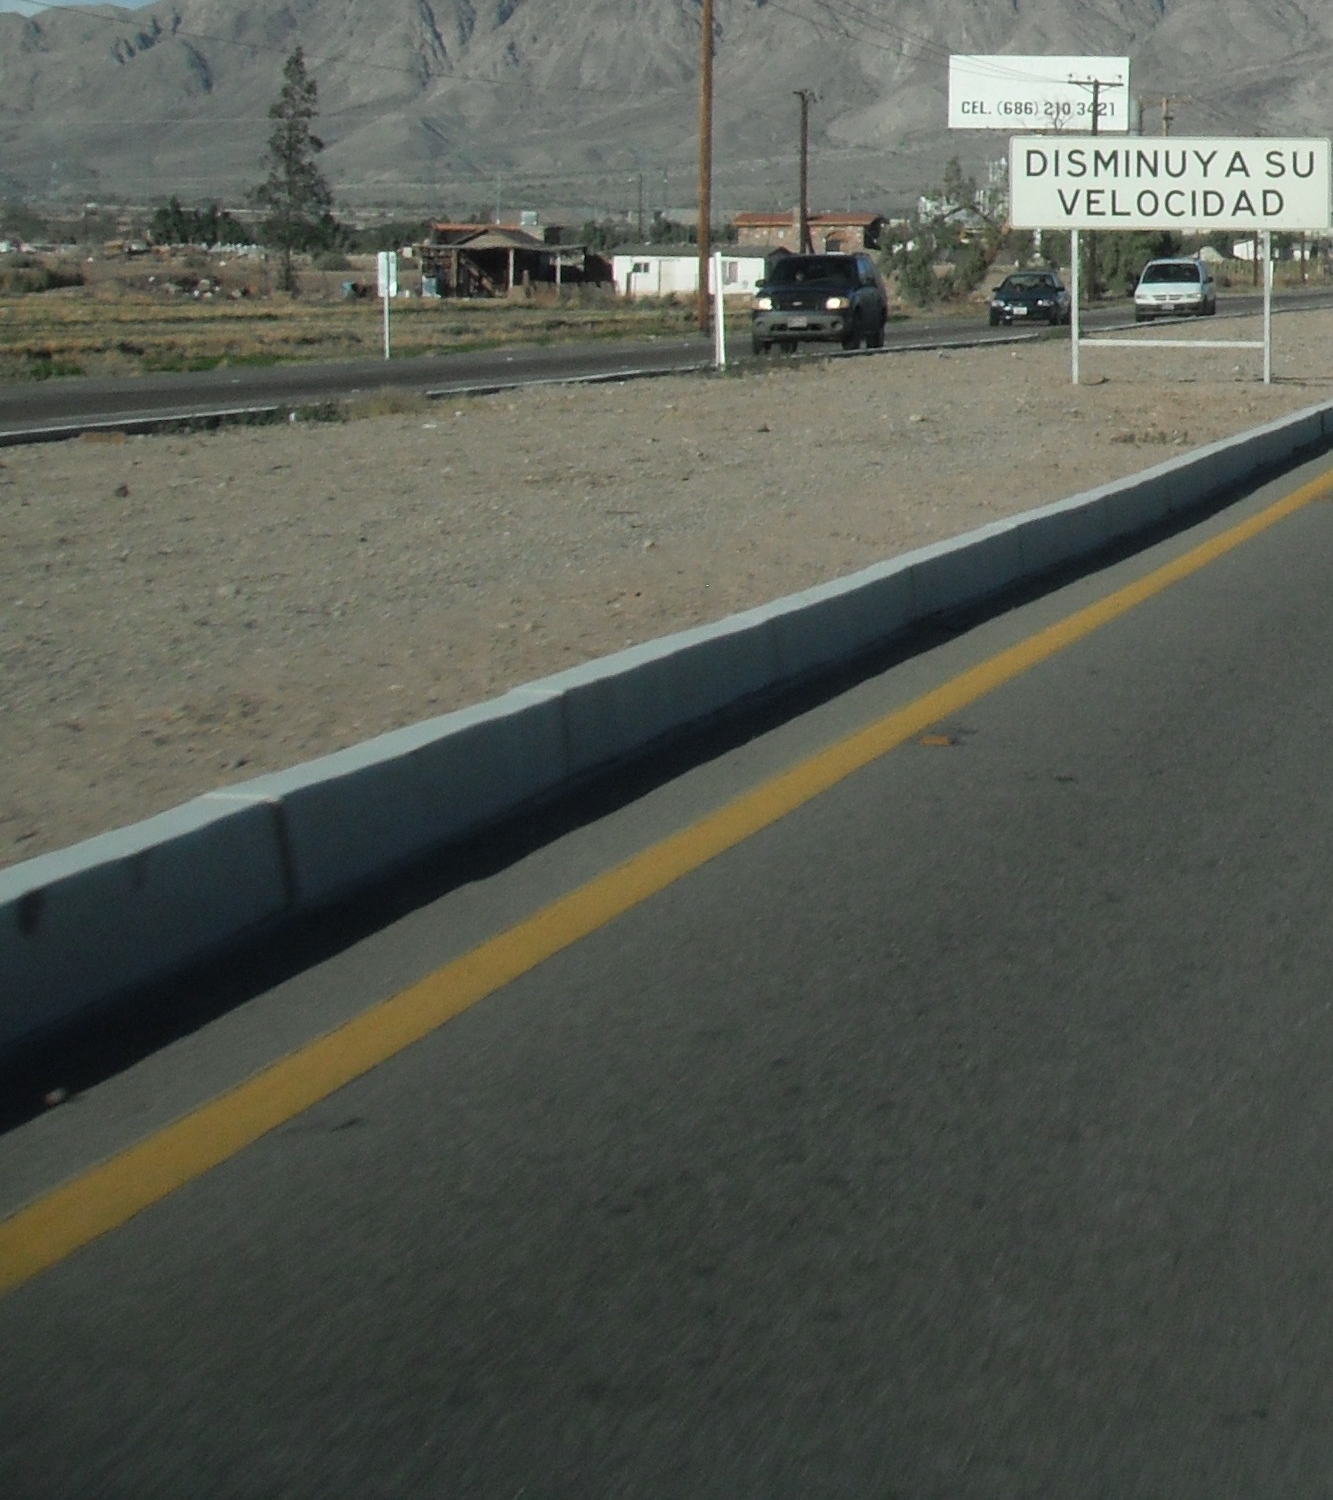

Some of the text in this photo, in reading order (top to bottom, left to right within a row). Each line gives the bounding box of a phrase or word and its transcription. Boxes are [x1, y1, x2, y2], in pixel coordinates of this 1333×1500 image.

[961, 100, 992, 115] CEL.
[997, 100, 1039, 116] (686)
[1043, 101, 1071, 116] 210
[1025, 149, 1315, 179] DISMINUYA SU
[1057, 188, 1285, 217] VELOCIDAD
